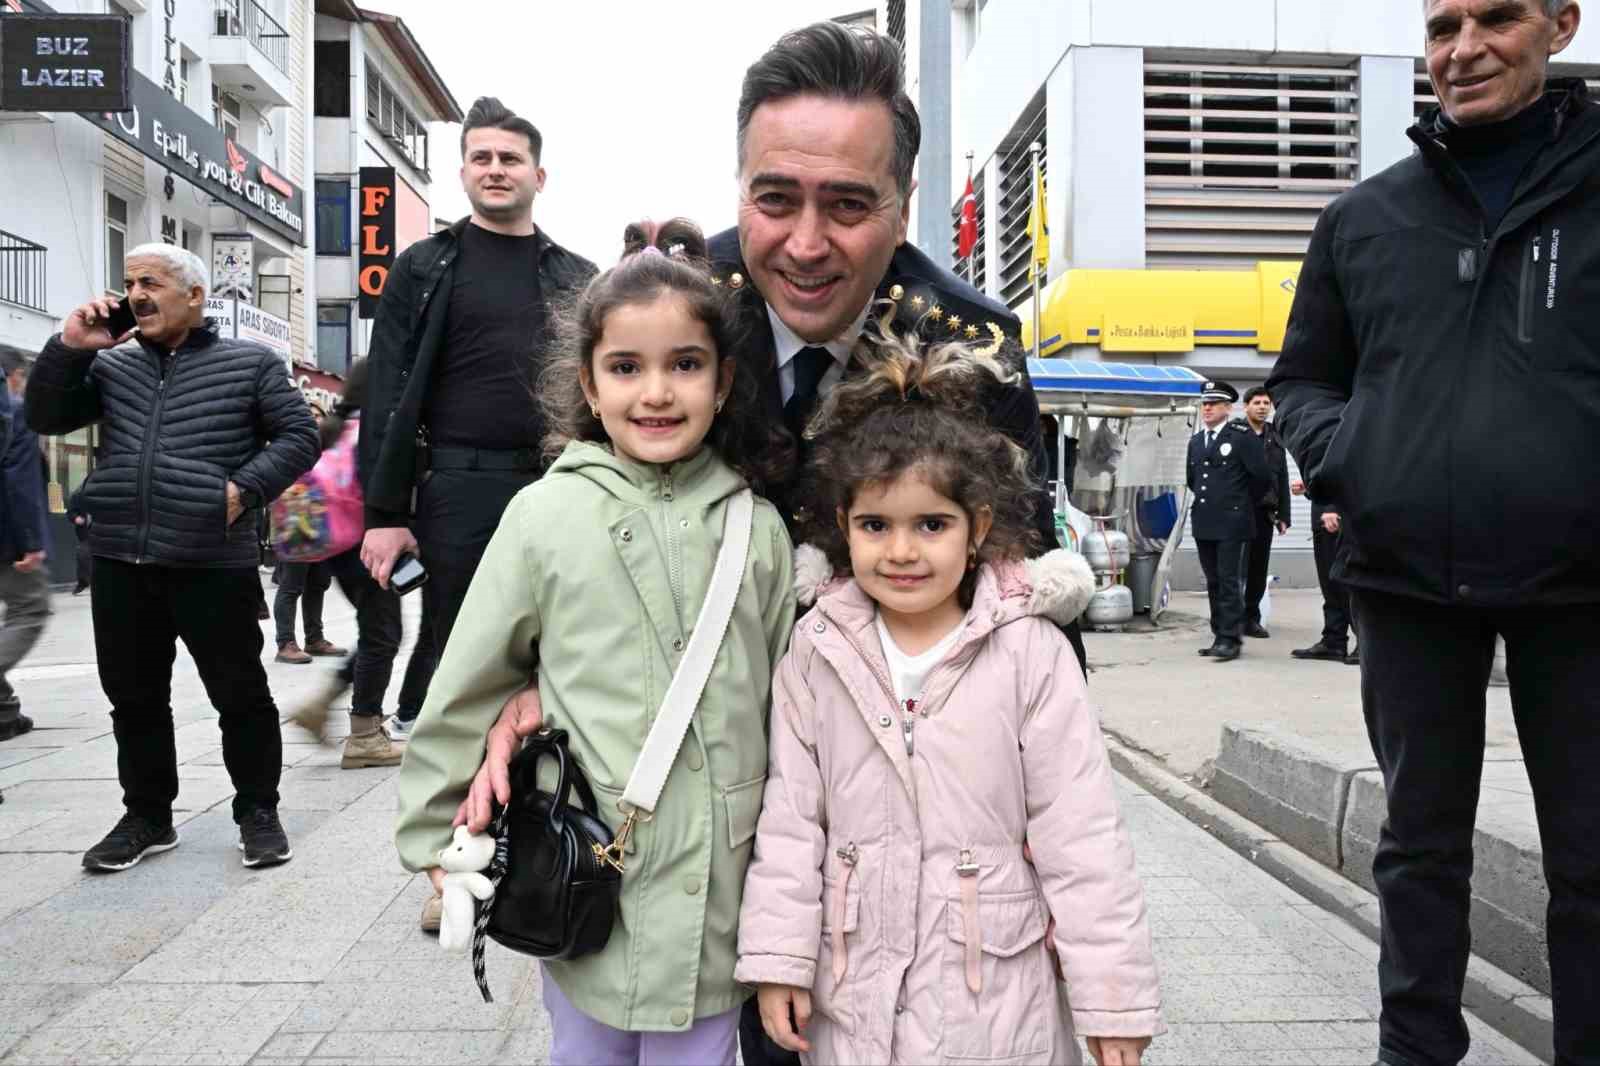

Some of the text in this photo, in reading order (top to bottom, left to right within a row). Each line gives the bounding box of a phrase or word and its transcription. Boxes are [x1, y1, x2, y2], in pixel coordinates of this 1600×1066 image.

[36, 37, 89, 55] BUZ
[21, 68, 105, 87] LAZER
[360, 186, 391, 296] FLO
[240, 308, 261, 331] ARAS
